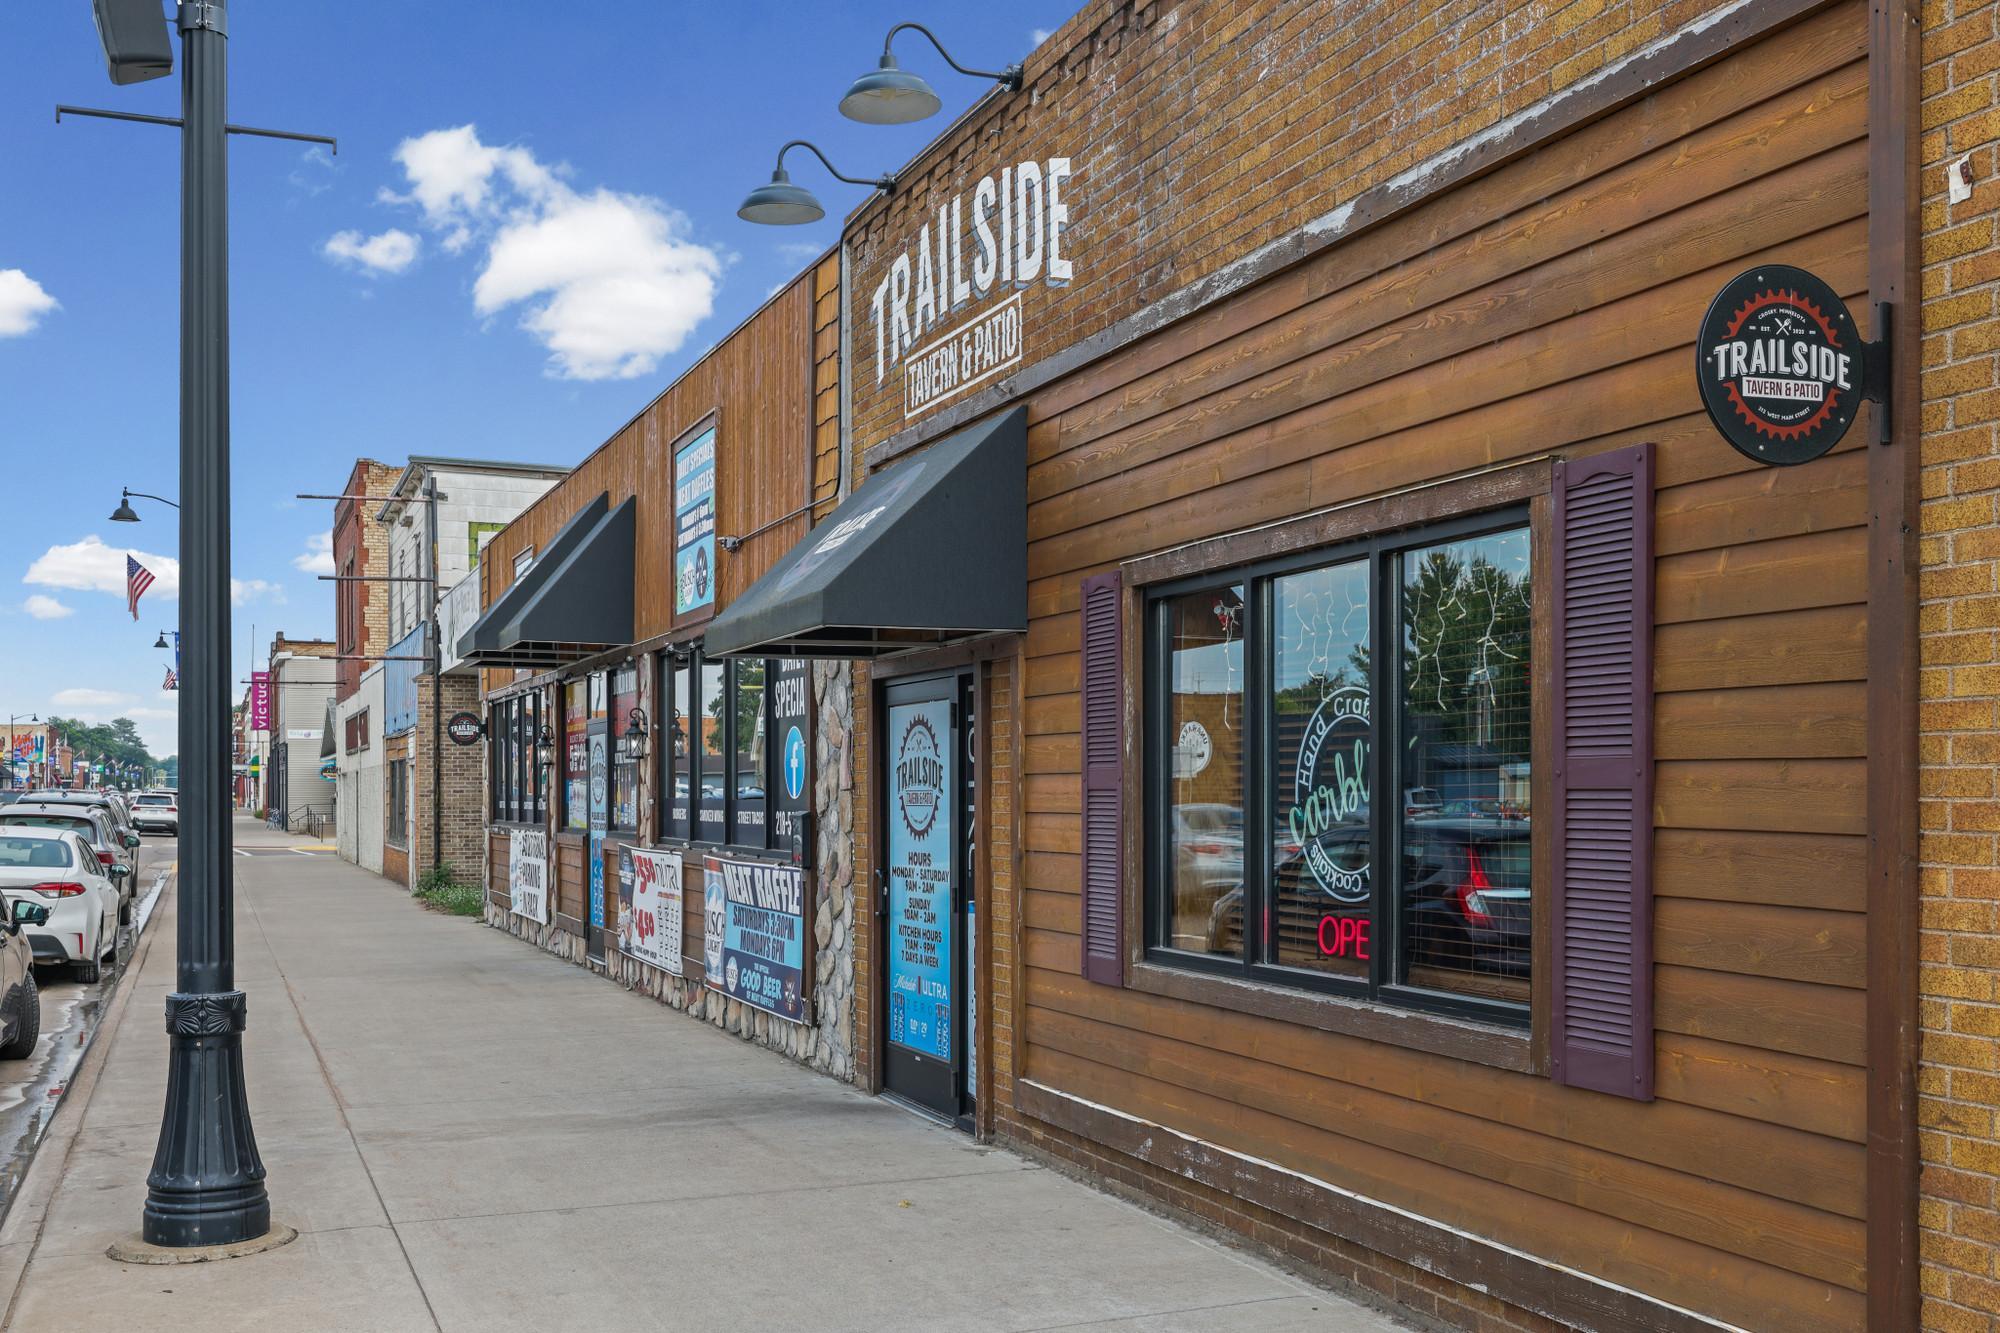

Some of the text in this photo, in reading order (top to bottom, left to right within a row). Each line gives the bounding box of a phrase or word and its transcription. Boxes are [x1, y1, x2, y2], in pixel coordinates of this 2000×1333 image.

[871, 157, 1073, 385] TRAILSIDE
[908, 306, 1017, 408] TAVERN & PATIO
[1713, 339, 1851, 390] TRAILSIDE
[1746, 379, 1820, 398] TAVERN & PATIO
[690, 438, 714, 472] SPECIALS
[775, 677, 806, 719] SPECIA
[450, 724, 479, 733] TRAILSIDE
[1299, 714, 1327, 786] Hand
[896, 756, 944, 796] TRAILSIDE
[737, 810, 751, 824] STREET
[891, 866, 916, 879] MONDAY
[920, 868, 950, 883] SATURDAY
[908, 851, 932, 867] HOURS
[1310, 844, 1362, 893] Cocktails
[722, 863, 801, 915] MEAT RAFFLE
[905, 880, 917, 892] 9AM
[922, 882, 935, 894] 2AM
[904, 909, 919, 921] 10AM
[924, 911, 936, 924] 2AM
[909, 897, 931, 911] SUNDAY
[733, 905, 795, 941] SATURDAYS 3:30PM
[898, 924, 943, 943] KITCHEN HOURS
[1318, 915, 1370, 960] OPE
[740, 929, 785, 964] MONDAYS 6PM
[901, 950, 939, 968] 7 DAYS A WEEK
[904, 938, 919, 951] 11AM
[923, 942, 936, 955] 9PM
[740, 967, 782, 1000] GOOD BEER
[922, 979, 948, 1000] ULTRA
